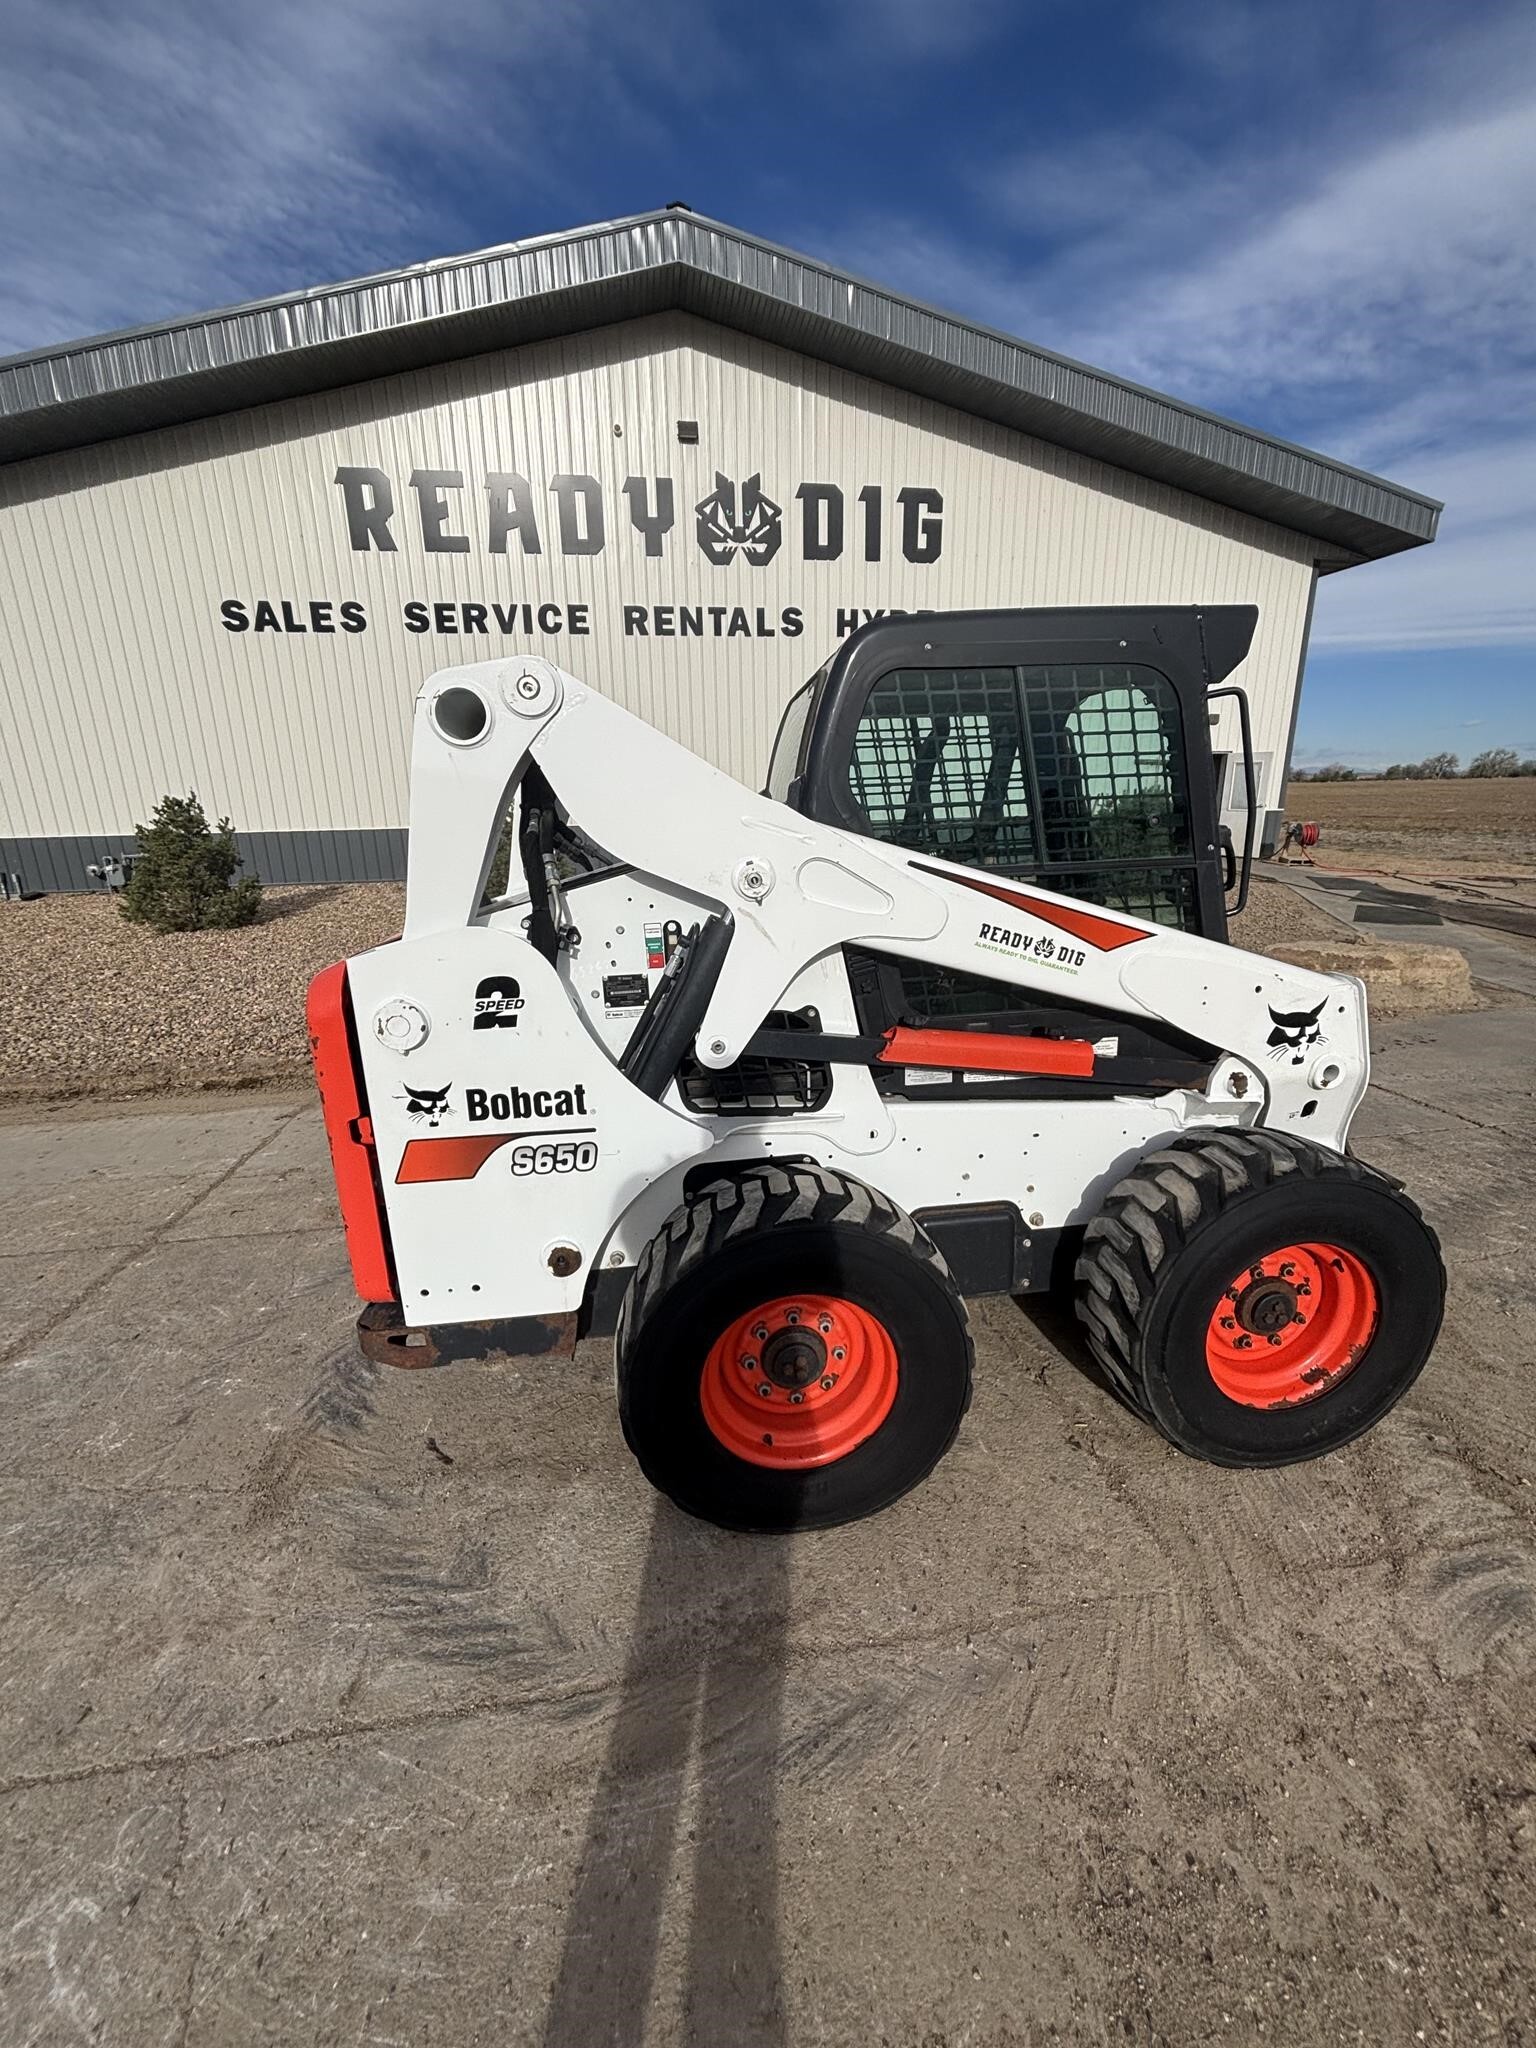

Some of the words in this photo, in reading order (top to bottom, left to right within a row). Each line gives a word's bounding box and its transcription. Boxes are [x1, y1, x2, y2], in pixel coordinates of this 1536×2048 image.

[334, 467, 675, 557] READY
[795, 483, 943, 563] DIG
[220, 600, 366, 633] SALES
[404, 602, 590, 635] SERVICE
[624, 605, 804, 637] RENTALS
[974, 941, 998, 952] ALWAYS
[999, 948, 1018, 957] READY
[979, 923, 1033, 951] READY
[1057, 946, 1086, 967] DIG
[473, 976, 520, 1030] 2
[475, 999, 525, 1012] SPEED
[466, 1084, 587, 1121] Bobcat
[511, 1142, 598, 1176] S650
